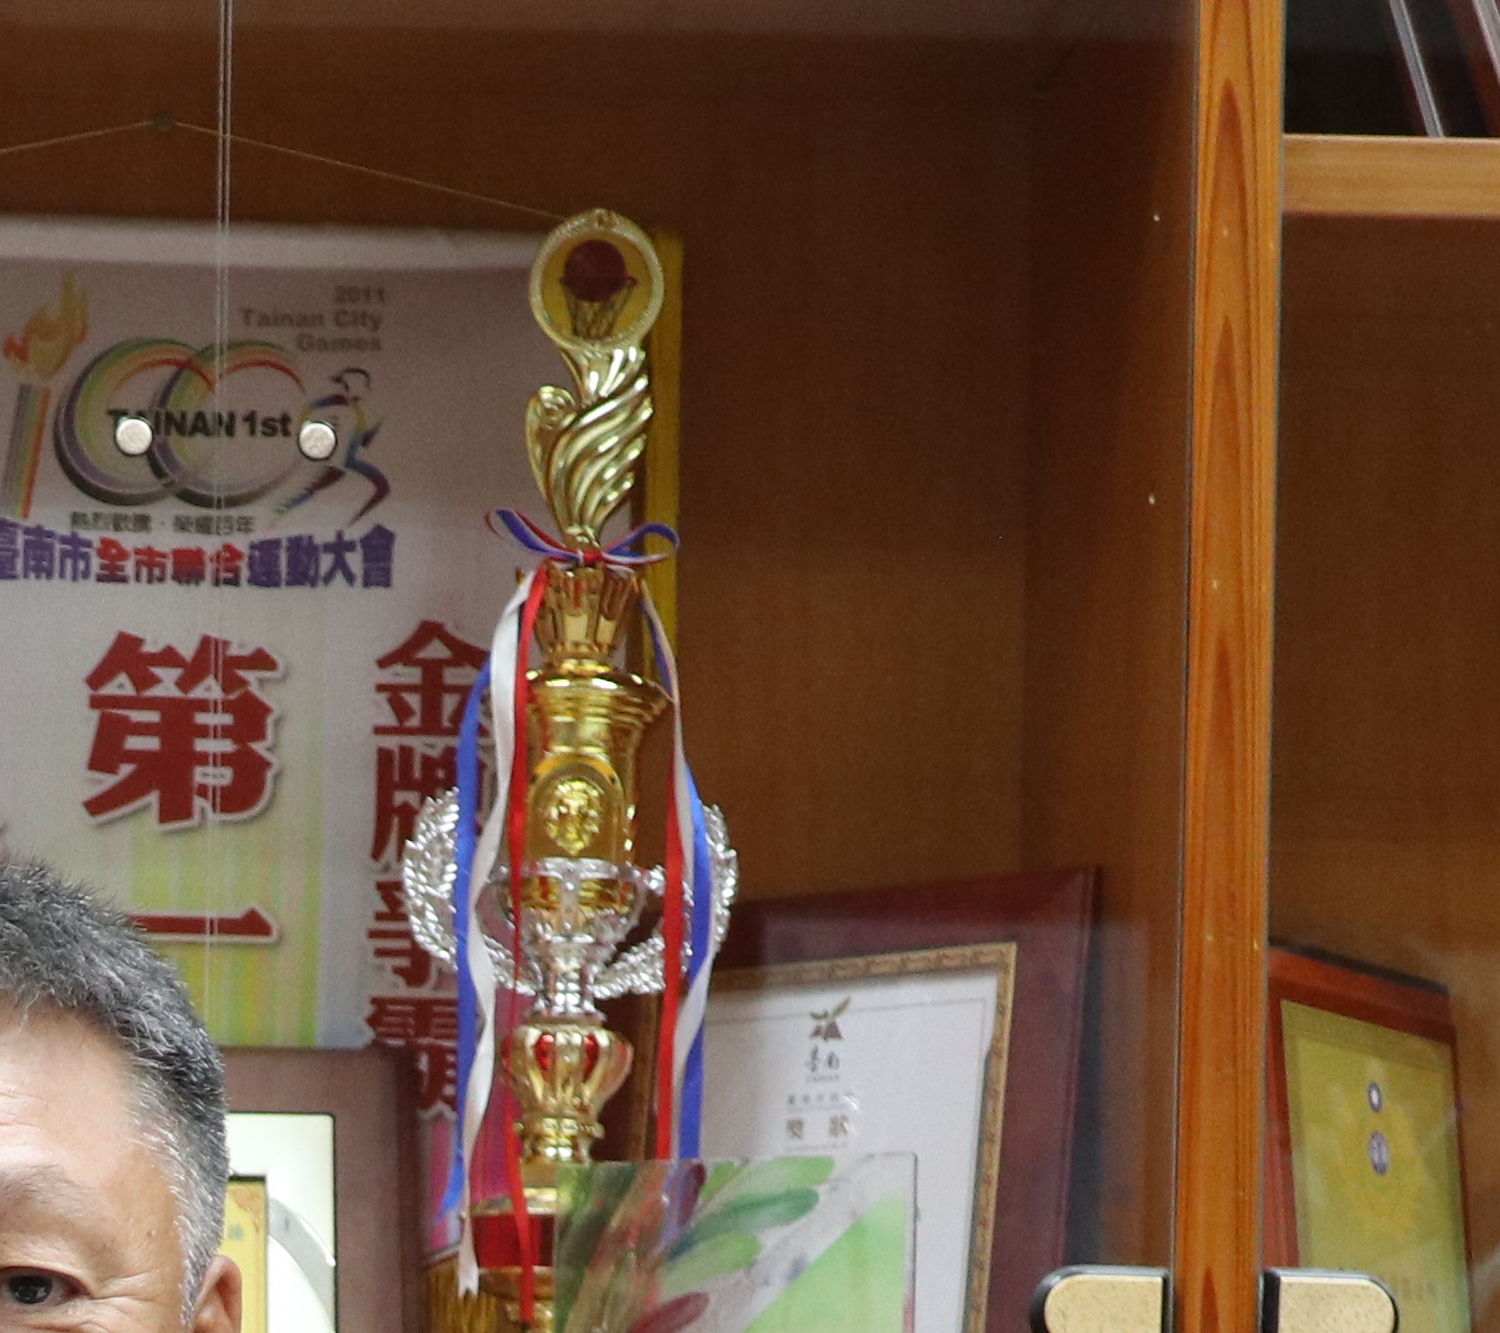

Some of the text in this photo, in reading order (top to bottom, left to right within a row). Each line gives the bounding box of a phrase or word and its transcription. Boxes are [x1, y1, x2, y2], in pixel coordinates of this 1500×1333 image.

[241, 309, 383, 332] Tainan City
[296, 334, 382, 352] Games
[106, 409, 292, 438] TINAN 1st
